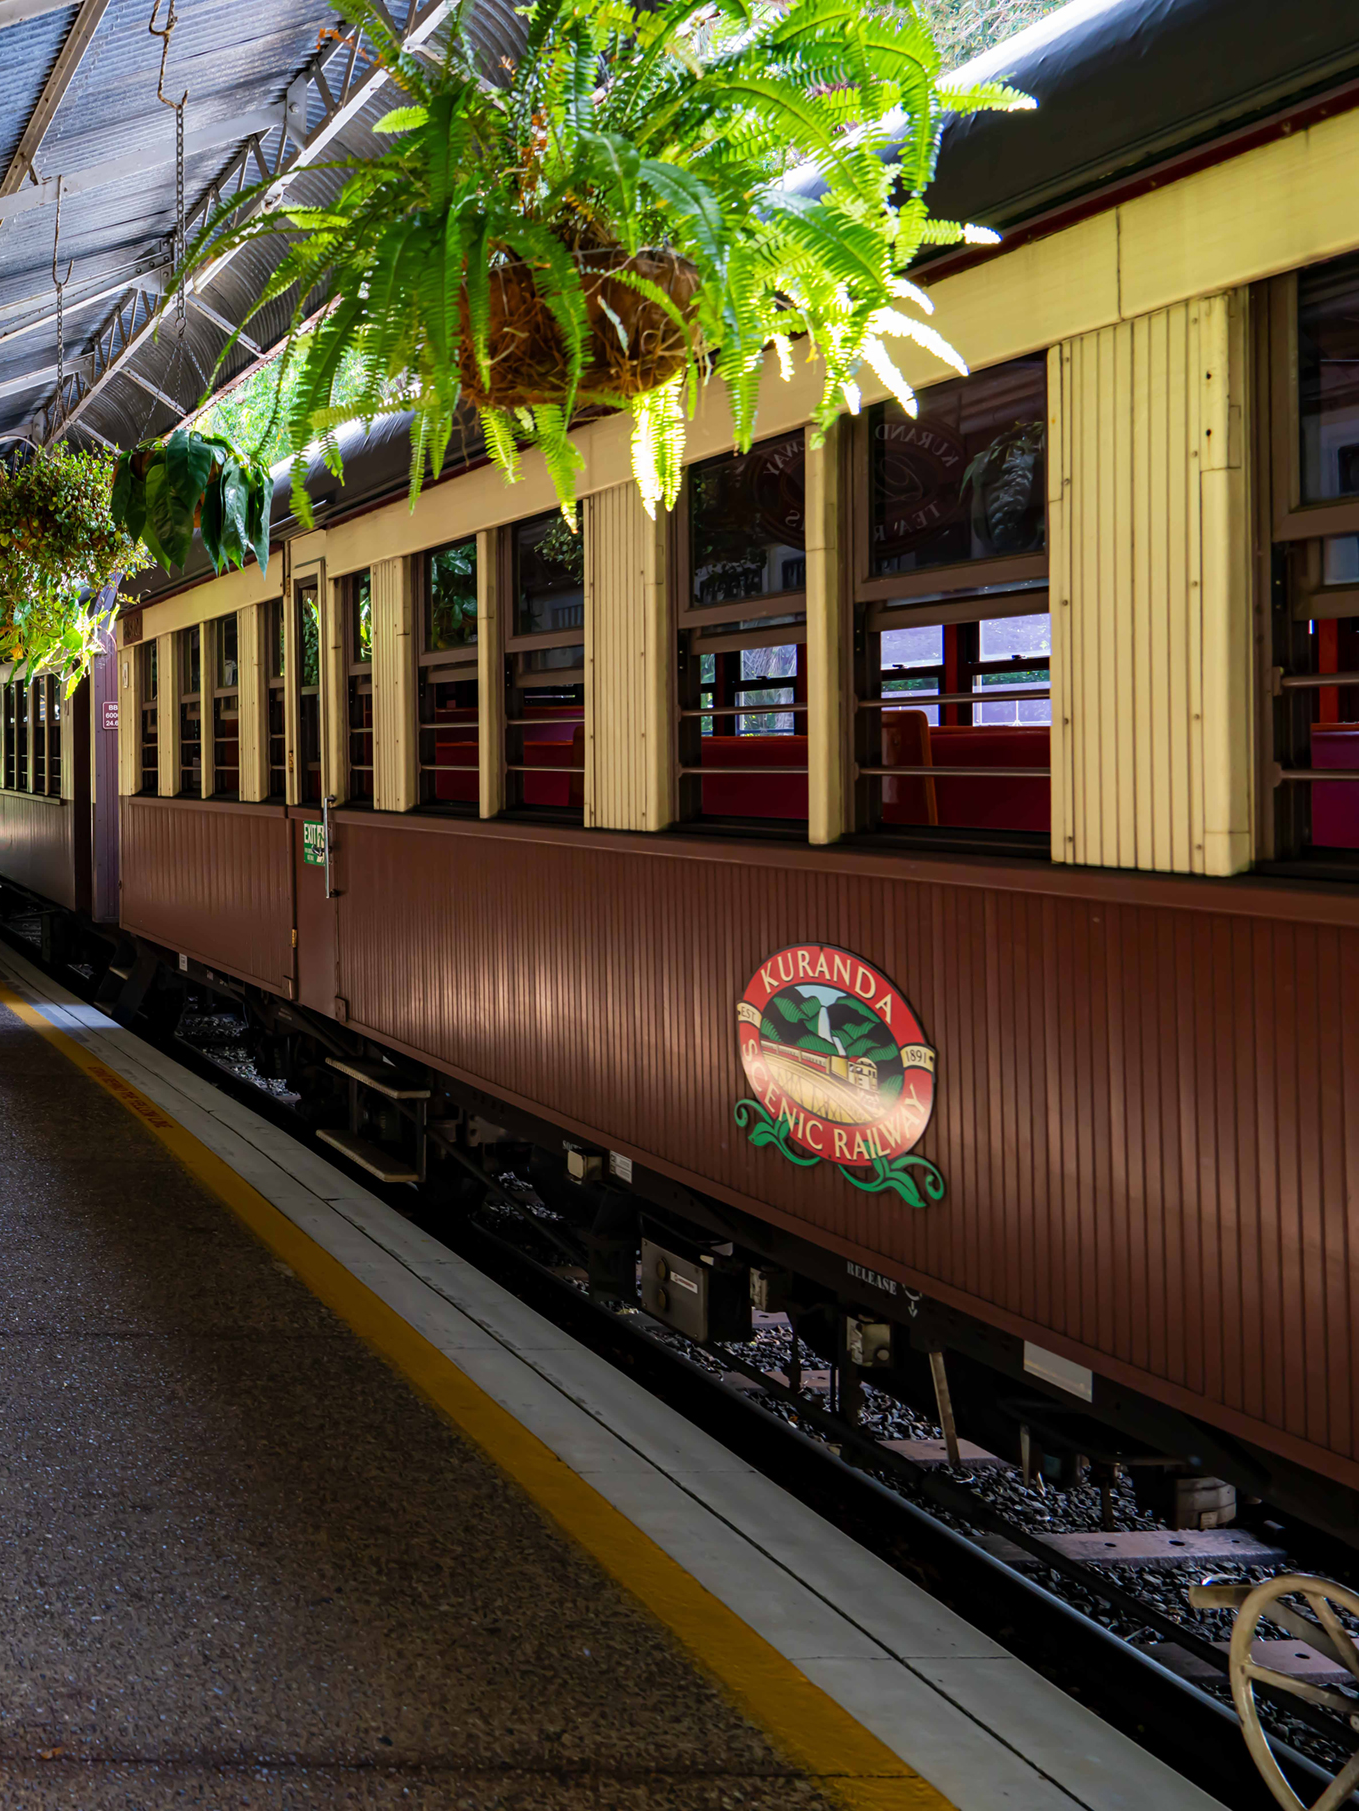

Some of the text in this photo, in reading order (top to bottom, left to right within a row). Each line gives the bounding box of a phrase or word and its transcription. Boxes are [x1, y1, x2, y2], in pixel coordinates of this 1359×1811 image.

[304, 823, 317, 845] EXIT
[760, 950, 893, 1025] KURANDA
[740, 1008, 757, 1020] EST.
[905, 1049, 927, 1065] 1891
[742, 1038, 926, 1161] SCENIC RAILWAY
[846, 1260, 898, 1296] RELEASE
